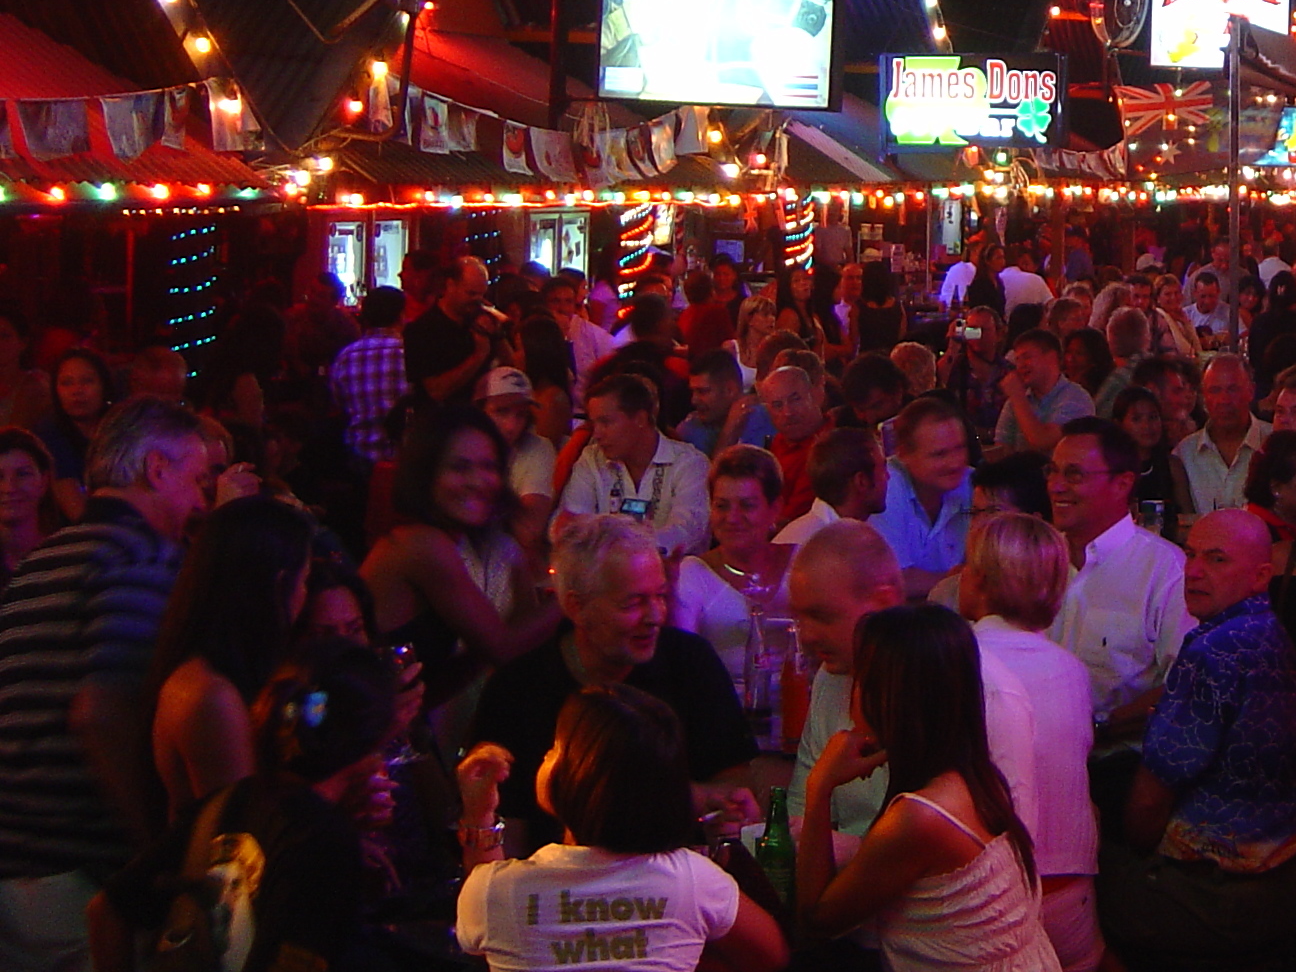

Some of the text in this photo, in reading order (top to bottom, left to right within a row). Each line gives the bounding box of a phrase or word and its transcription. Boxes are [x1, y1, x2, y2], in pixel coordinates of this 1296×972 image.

[892, 59, 1057, 102] James Dons
[560, 889, 668, 924] know
[550, 927, 648, 965] what
